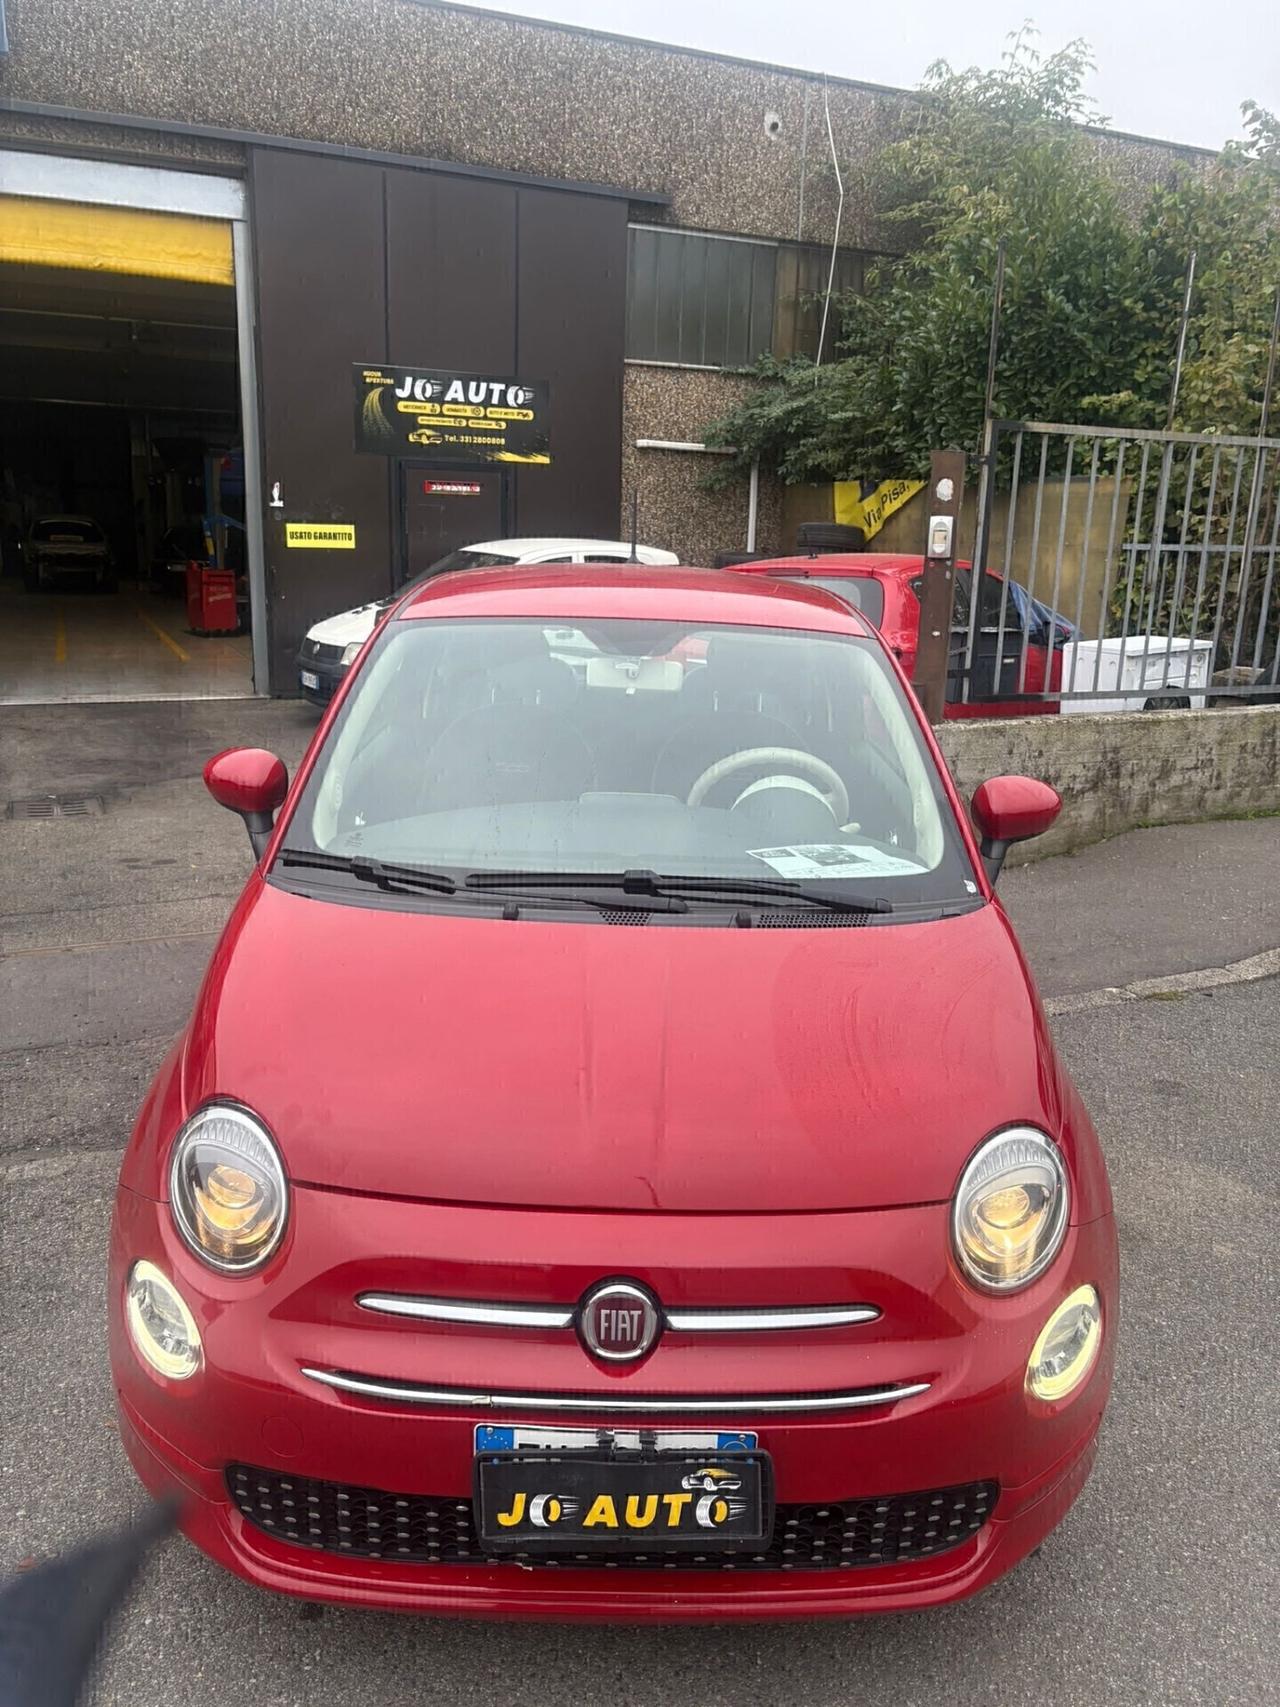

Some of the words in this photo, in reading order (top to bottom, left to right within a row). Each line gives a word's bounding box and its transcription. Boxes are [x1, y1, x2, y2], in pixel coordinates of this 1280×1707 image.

[444, 380, 525, 407] AUTO
[863, 508, 882, 529] Via
[289, 531, 312, 540] USATO
[313, 532, 353, 542] GARANTITO
[600, 1309, 643, 1342] FIAT
[582, 1493, 728, 1529] AUTO
